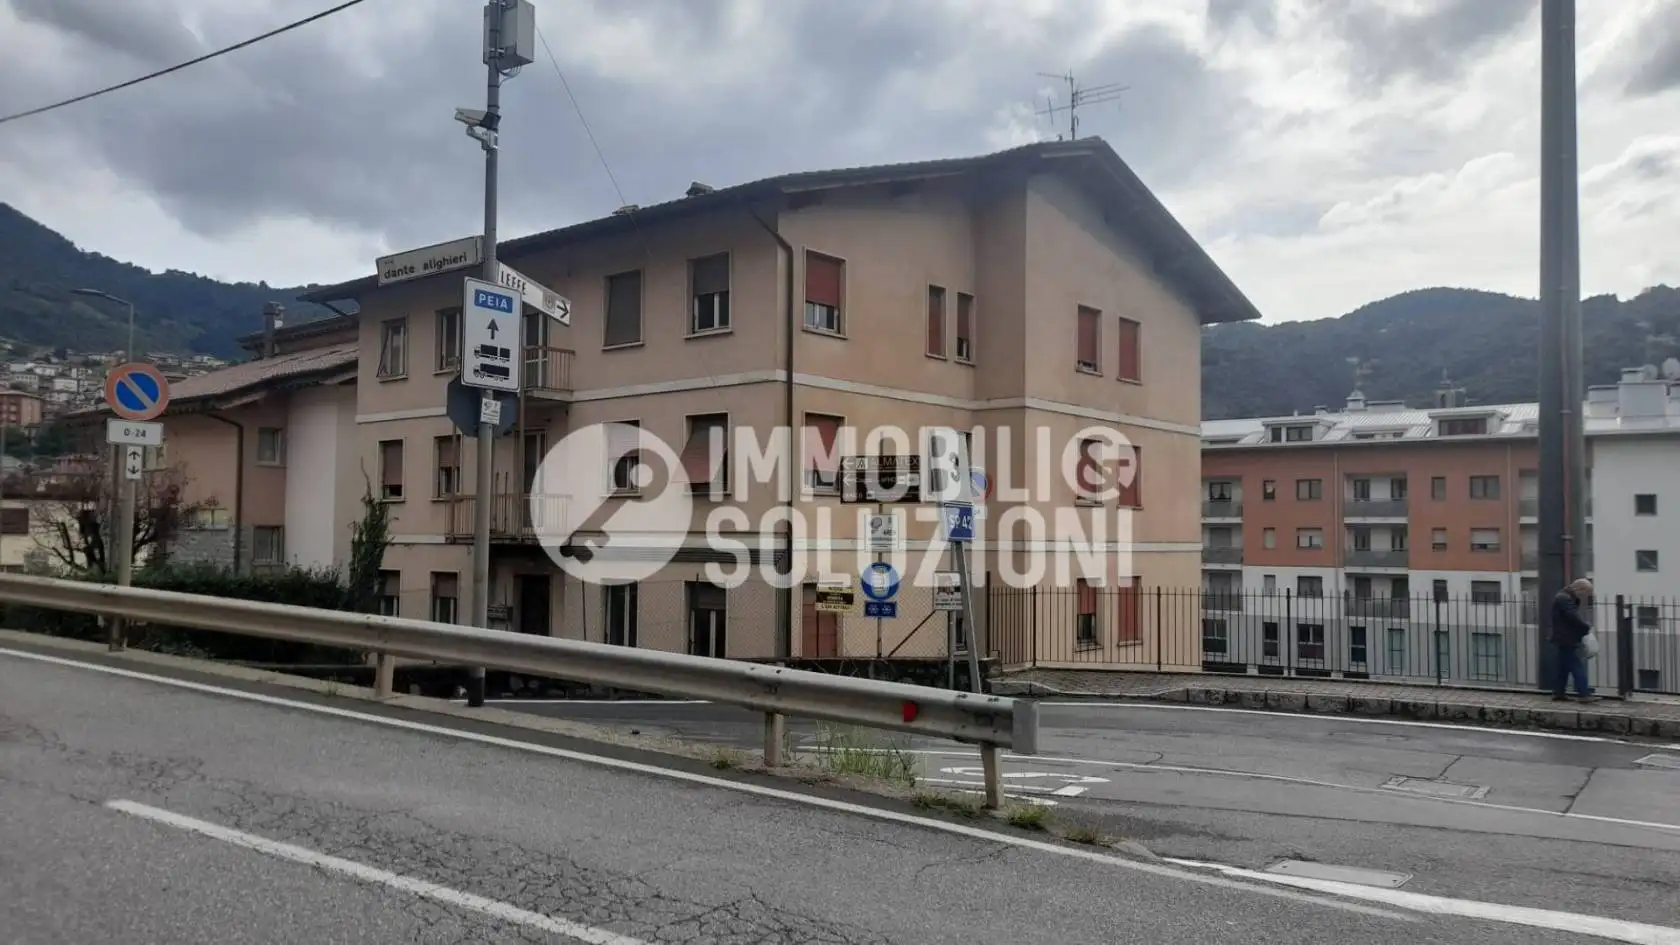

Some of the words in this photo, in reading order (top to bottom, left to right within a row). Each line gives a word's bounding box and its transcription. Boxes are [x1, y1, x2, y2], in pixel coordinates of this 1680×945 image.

[384, 265, 415, 279] dante
[423, 252, 467, 271] alighieri
[501, 271, 526, 296] LEFFE
[479, 293, 508, 310] PEIA
[949, 515, 960, 529] SP
[961, 513, 973, 529] 42
